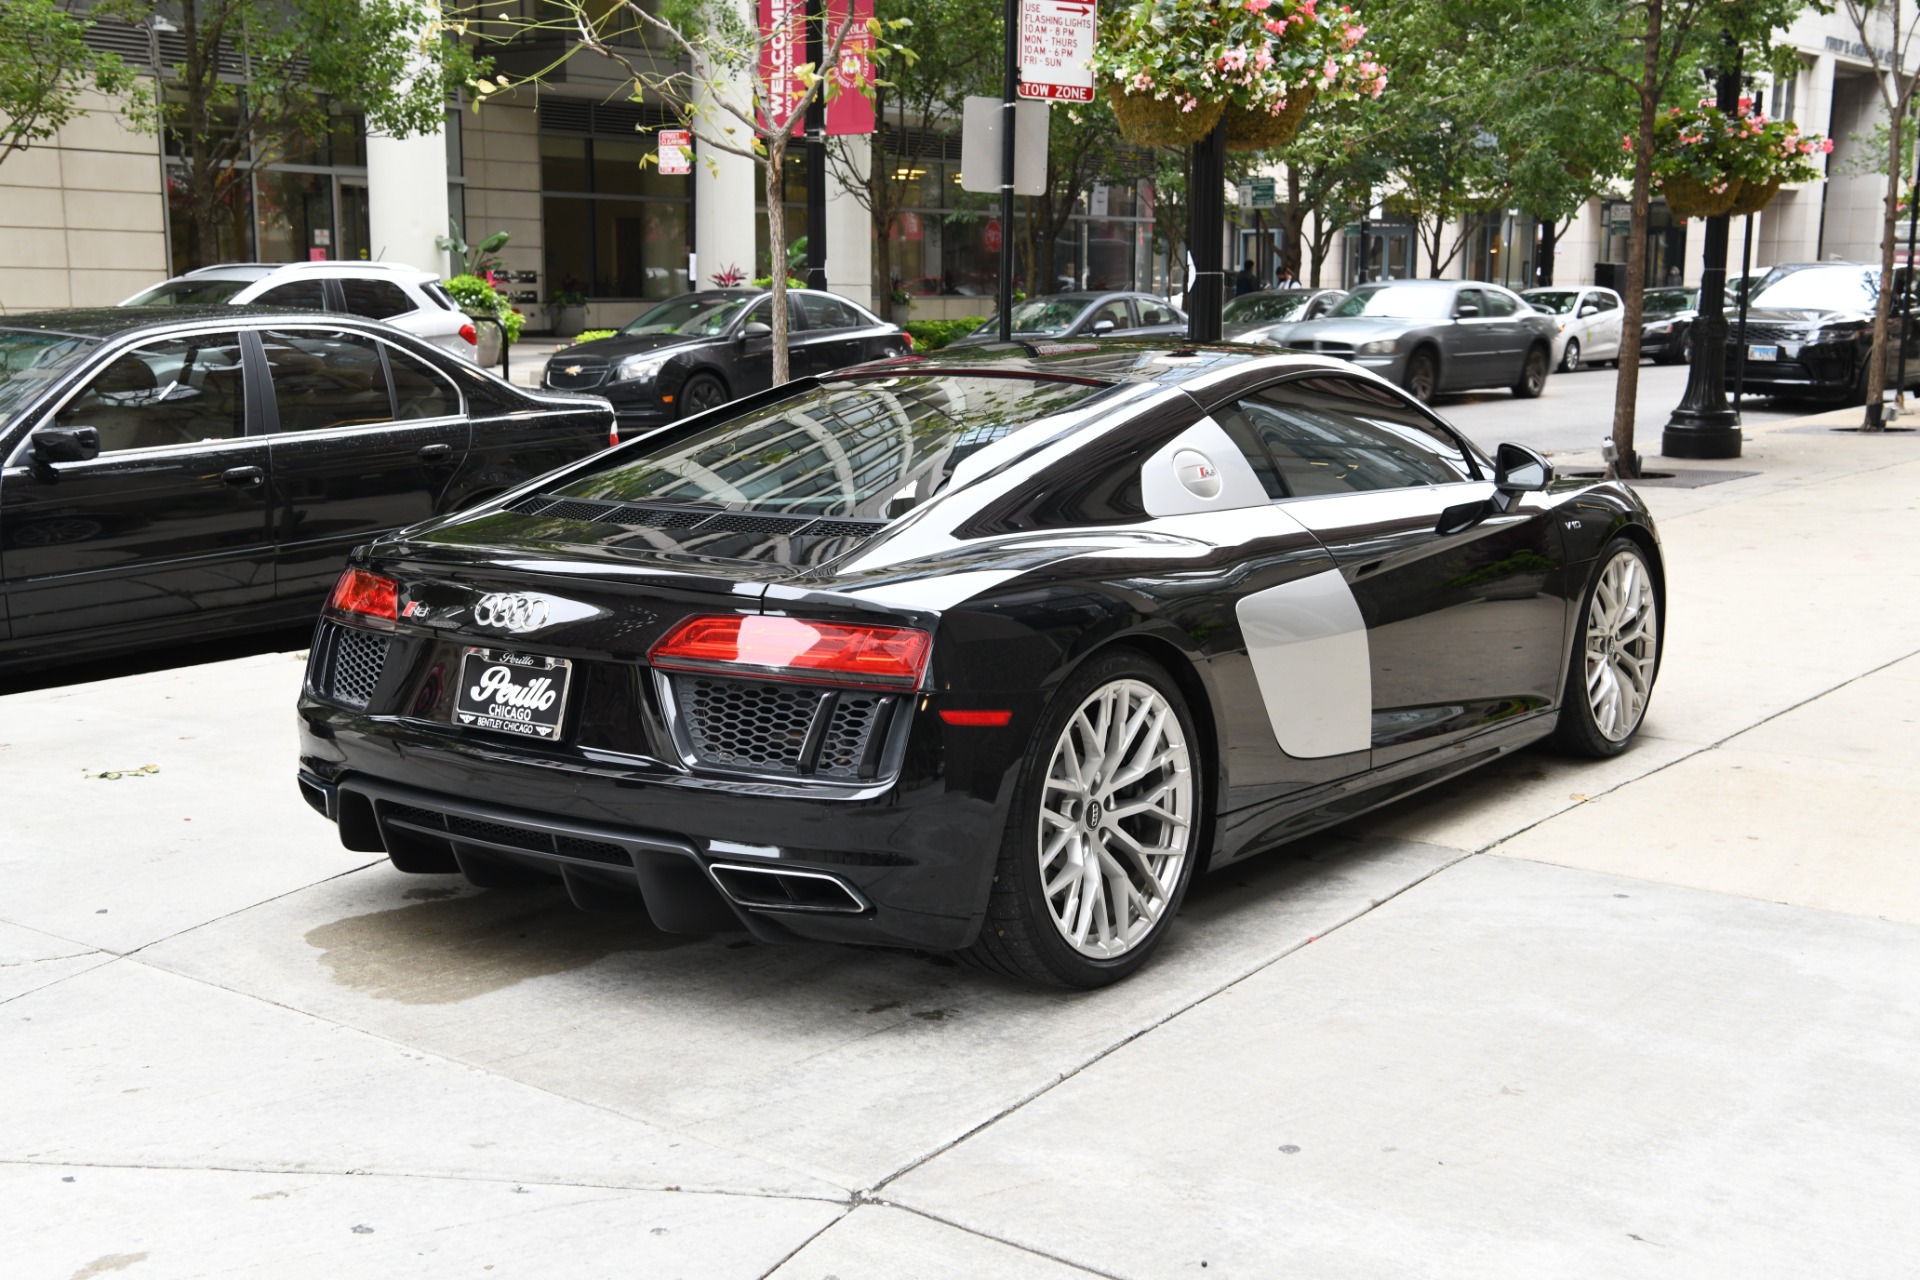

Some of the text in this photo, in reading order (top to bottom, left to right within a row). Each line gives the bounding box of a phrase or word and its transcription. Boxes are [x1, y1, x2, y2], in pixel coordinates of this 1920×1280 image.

[1025, 4, 1041, 13] USE
[1024, 14, 1091, 29] FLASHING LIGHTS
[833, 22, 868, 36] LOOLA
[1025, 24, 1034, 33] 10
[1035, 26, 1047, 34] AM
[1055, 27, 1061, 36] 8
[1062, 28, 1075, 36] PM
[1024, 35, 1042, 44] MON
[1051, 37, 1078, 48] THURS
[1024, 45, 1033, 54] 10
[1034, 47, 1046, 55] AM
[1054, 48, 1060, 57] 6
[1061, 49, 1073, 58] PM
[785, 41, 793, 78] TOWER
[1024, 56, 1038, 65] FRI
[1045, 58, 1062, 67] SUN
[1023, 83, 1087, 100] TOW ZONE
[785, 81, 793, 117] WATER
[1564, 520, 1582, 530] V10
[499, 652, 534, 666] Perillo
[470, 665, 556, 711] Perillo
[488, 703, 532, 721] CHICAGO
[477, 716, 534, 734] BENTLEY CHICAGO
